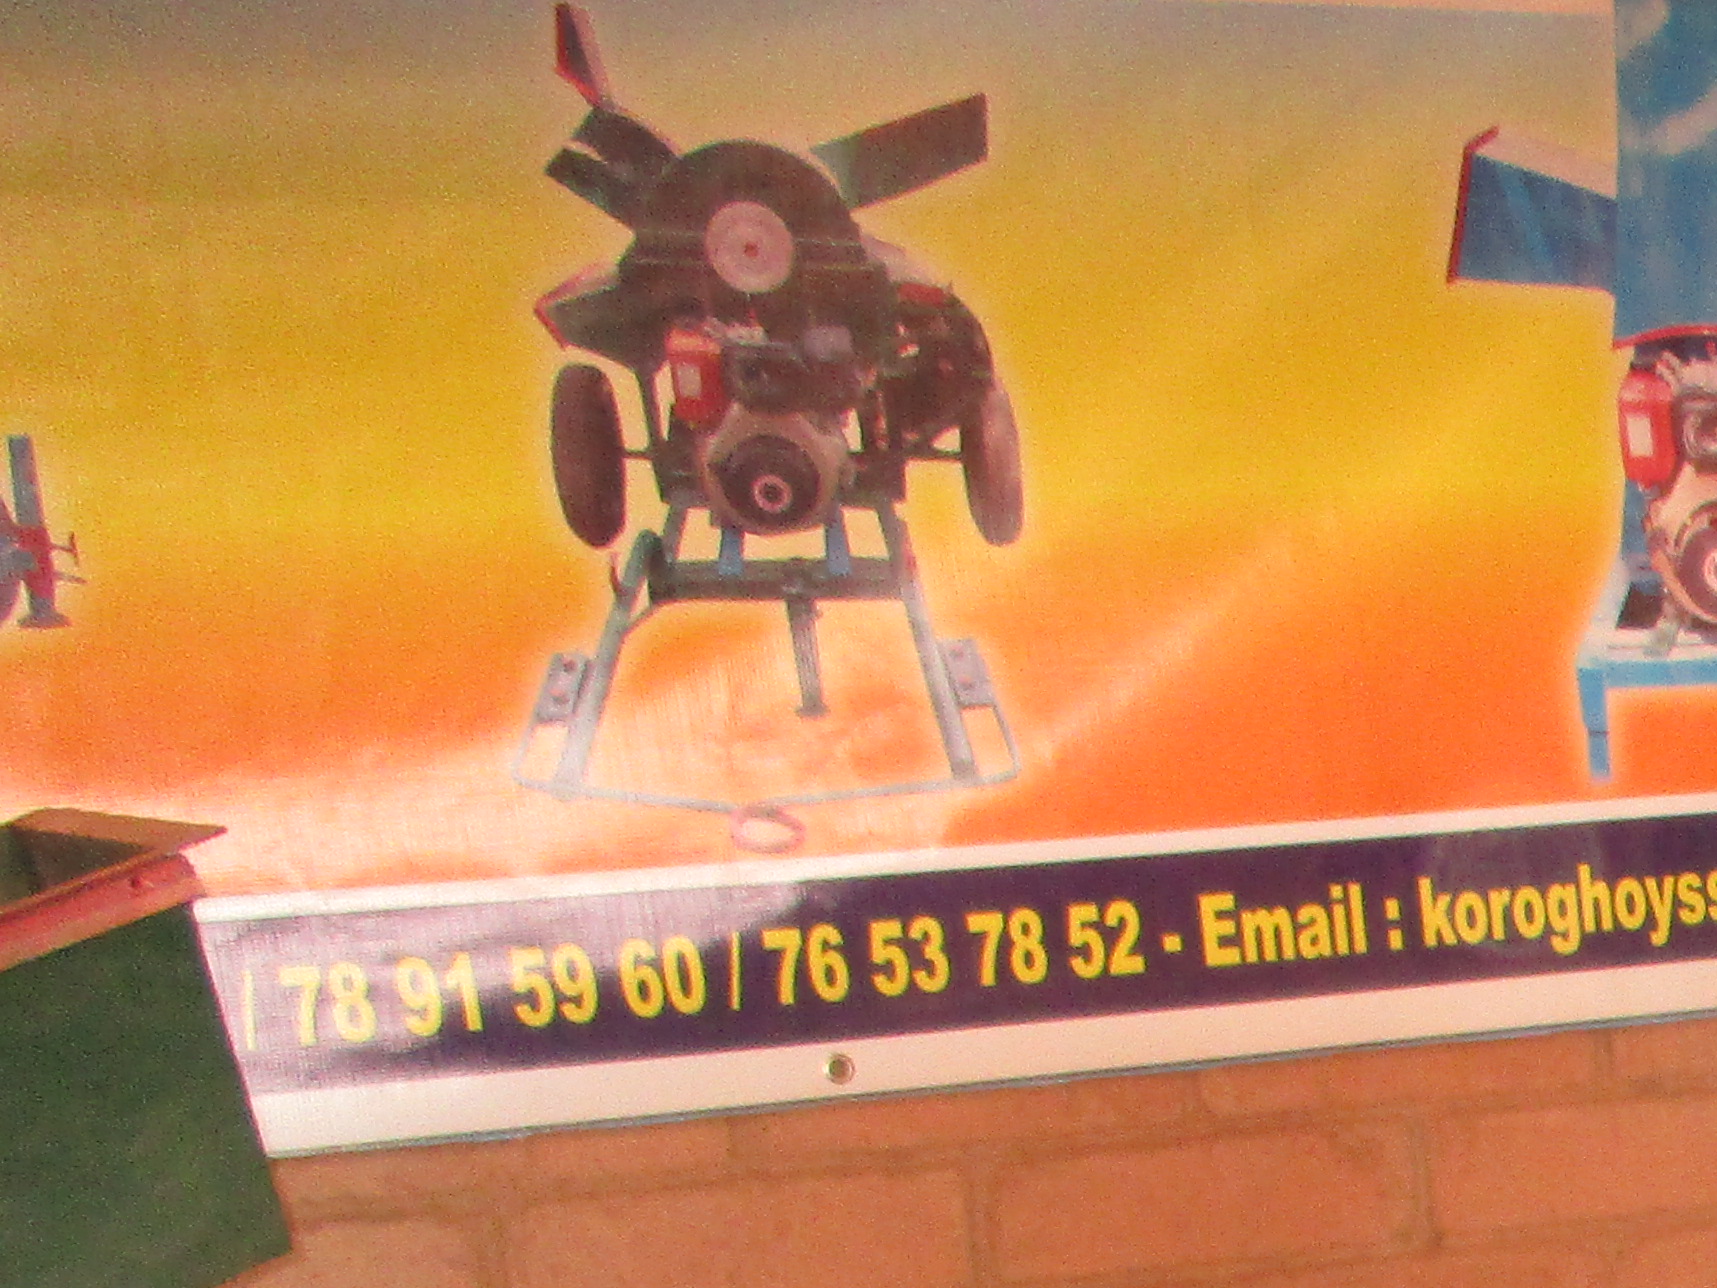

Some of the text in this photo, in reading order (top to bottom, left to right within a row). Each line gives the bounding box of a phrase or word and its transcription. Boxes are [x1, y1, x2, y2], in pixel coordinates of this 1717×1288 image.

[284, 960, 378, 1047] 78
[396, 954, 484, 1038] 91
[512, 941, 599, 1028] 59
[619, 932, 707, 1020] 60
[762, 922, 851, 1005] 76
[869, 915, 951, 998] 53
[967, 906, 1048, 989] 78
[1067, 898, 1146, 981] 52
[1198, 881, 1368, 969] Email
